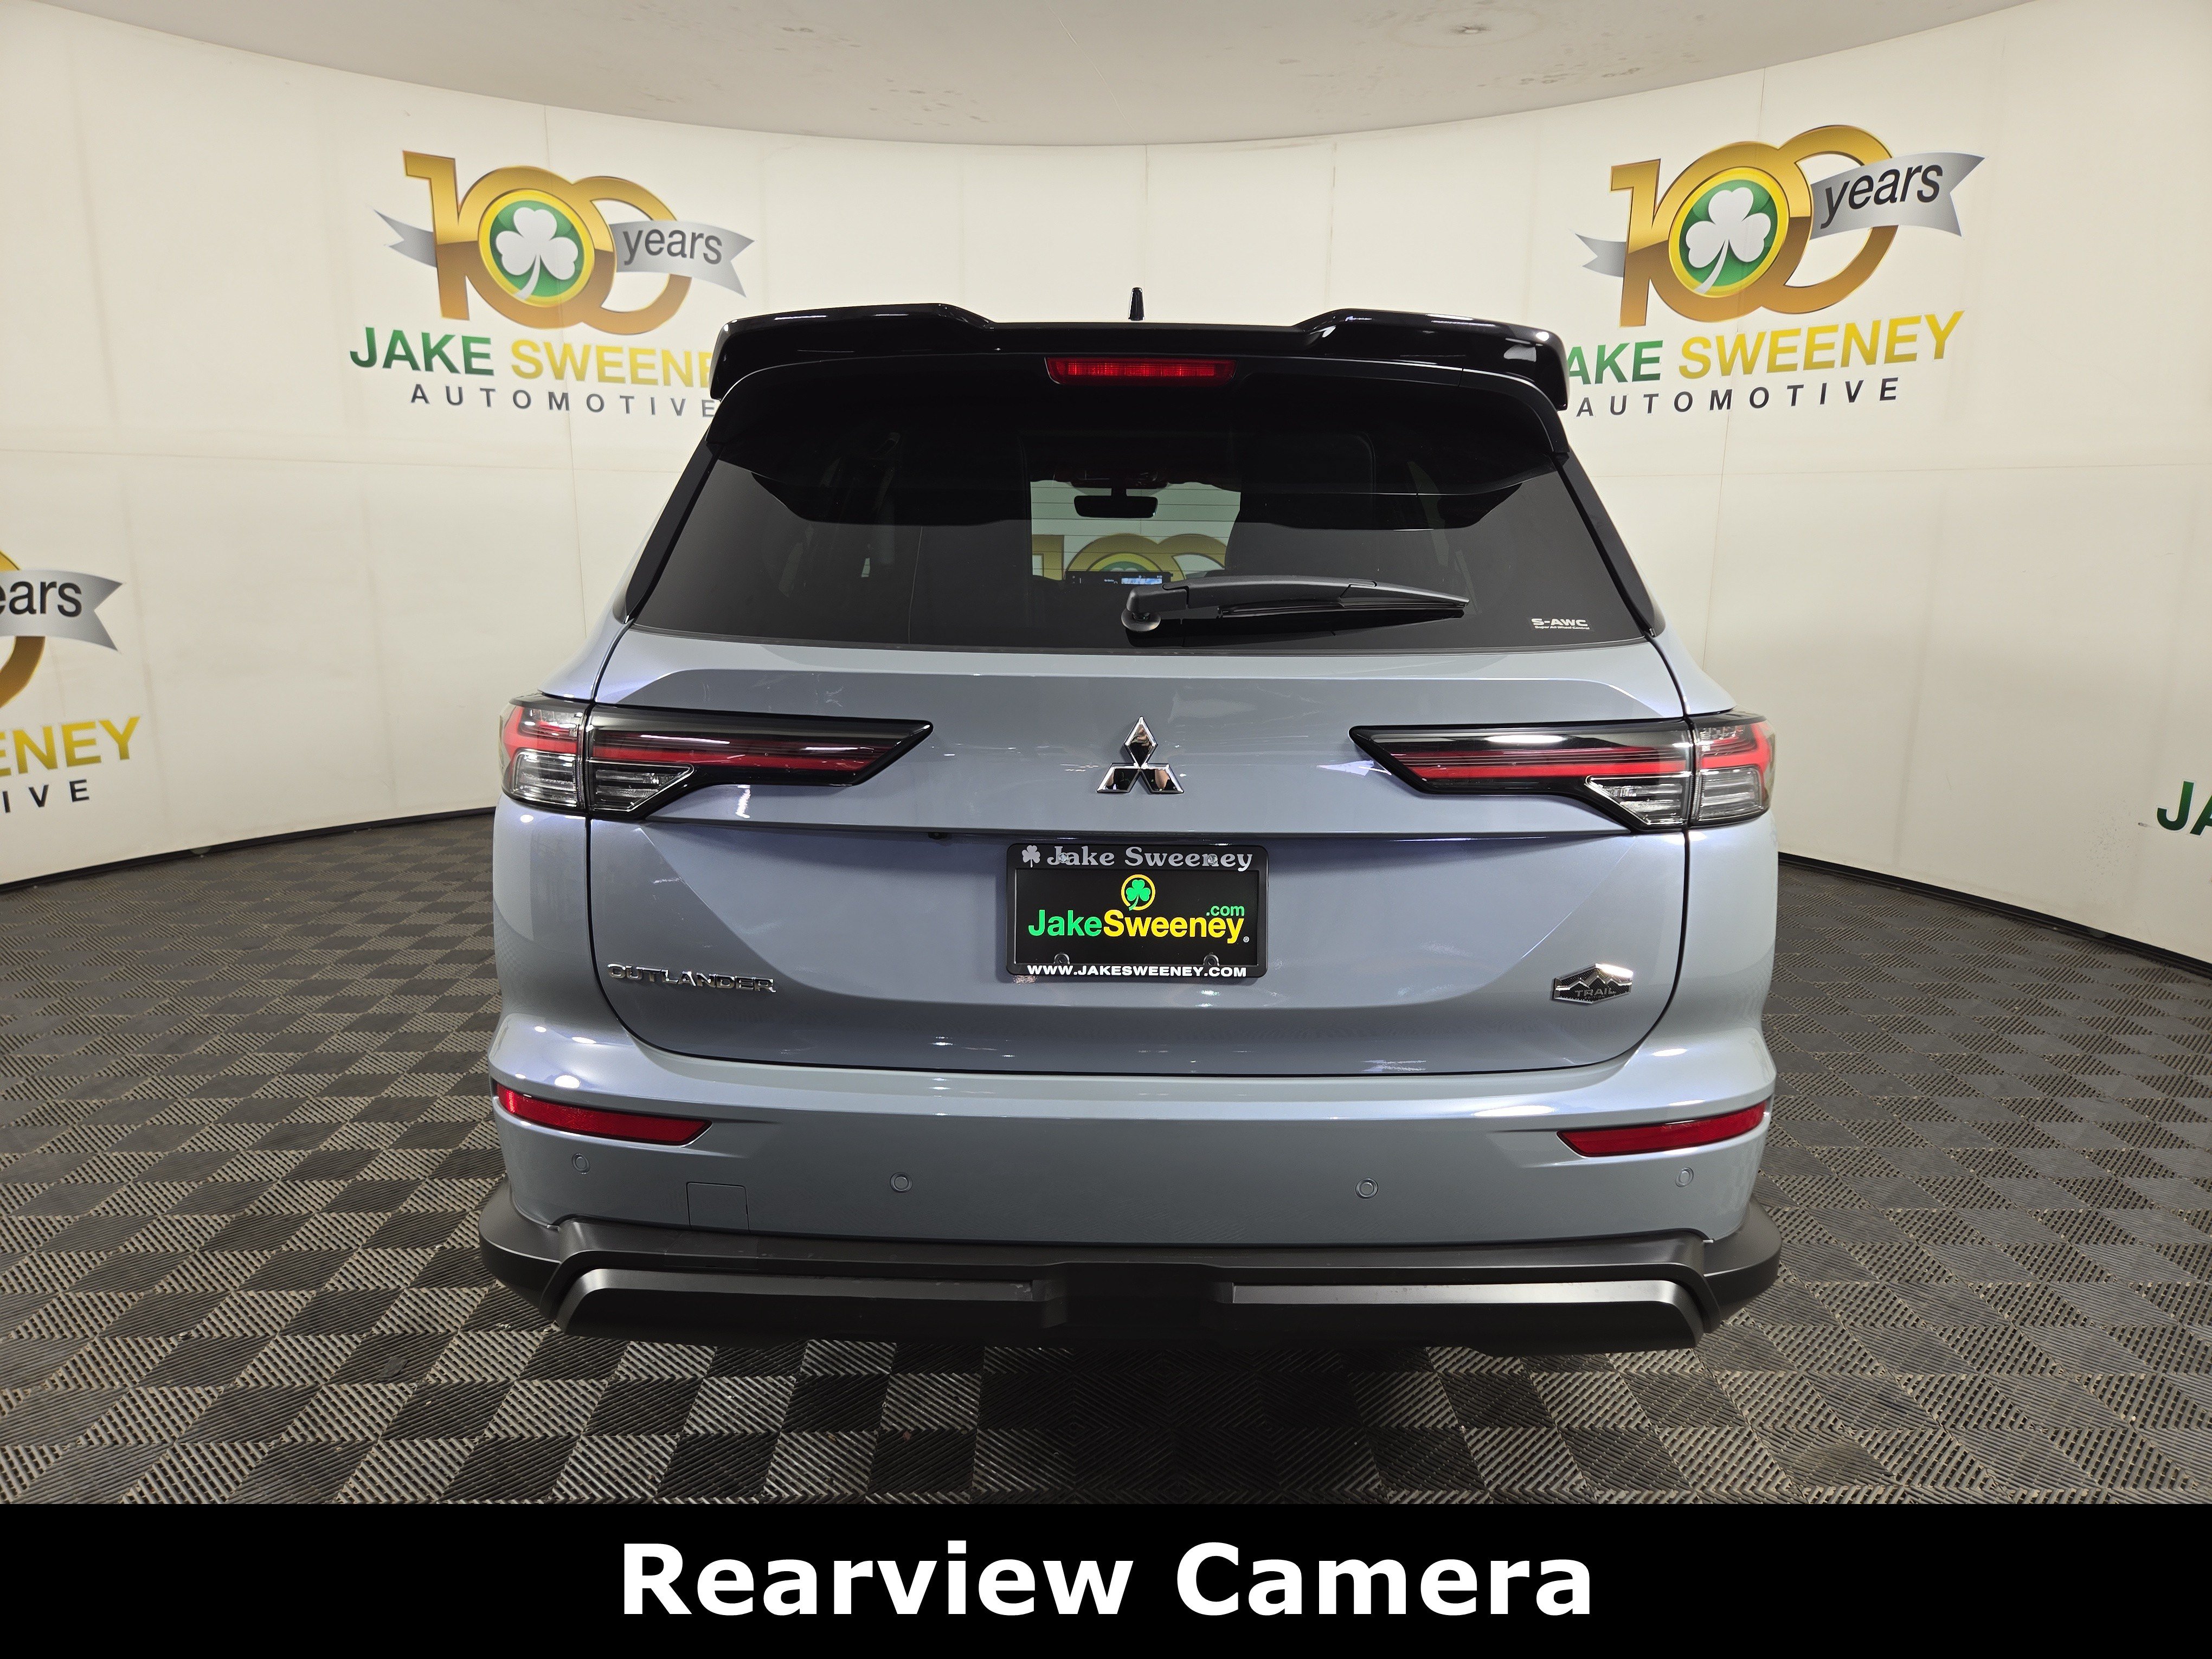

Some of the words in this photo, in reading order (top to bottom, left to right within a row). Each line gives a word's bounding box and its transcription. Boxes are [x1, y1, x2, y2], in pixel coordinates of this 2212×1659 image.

[1819, 163, 1943, 230] years
[403, 150, 693, 335] 100
[1610, 125, 1899, 327] 100
[622, 228, 723, 266] years
[350, 326, 494, 376] JAKE
[511, 339, 713, 388] SWEEN
[1567, 340, 1663, 385] AKE
[1679, 310, 1965, 380] SWEENEY
[410, 384, 715, 417] AUTOMOTIVE
[1576, 377, 1899, 417] AUTOMOTIVE
[1531, 618, 1588, 627] S-AWC
[1047, 846, 1115, 867] Jake
[1124, 847, 1252, 872] Sweeney
[607, 963, 776, 993] OUTLANDER
[1027, 964, 1247, 977] WWW.JAKESWEENEY.COM
[1574, 987, 1616, 997] TRAIL
